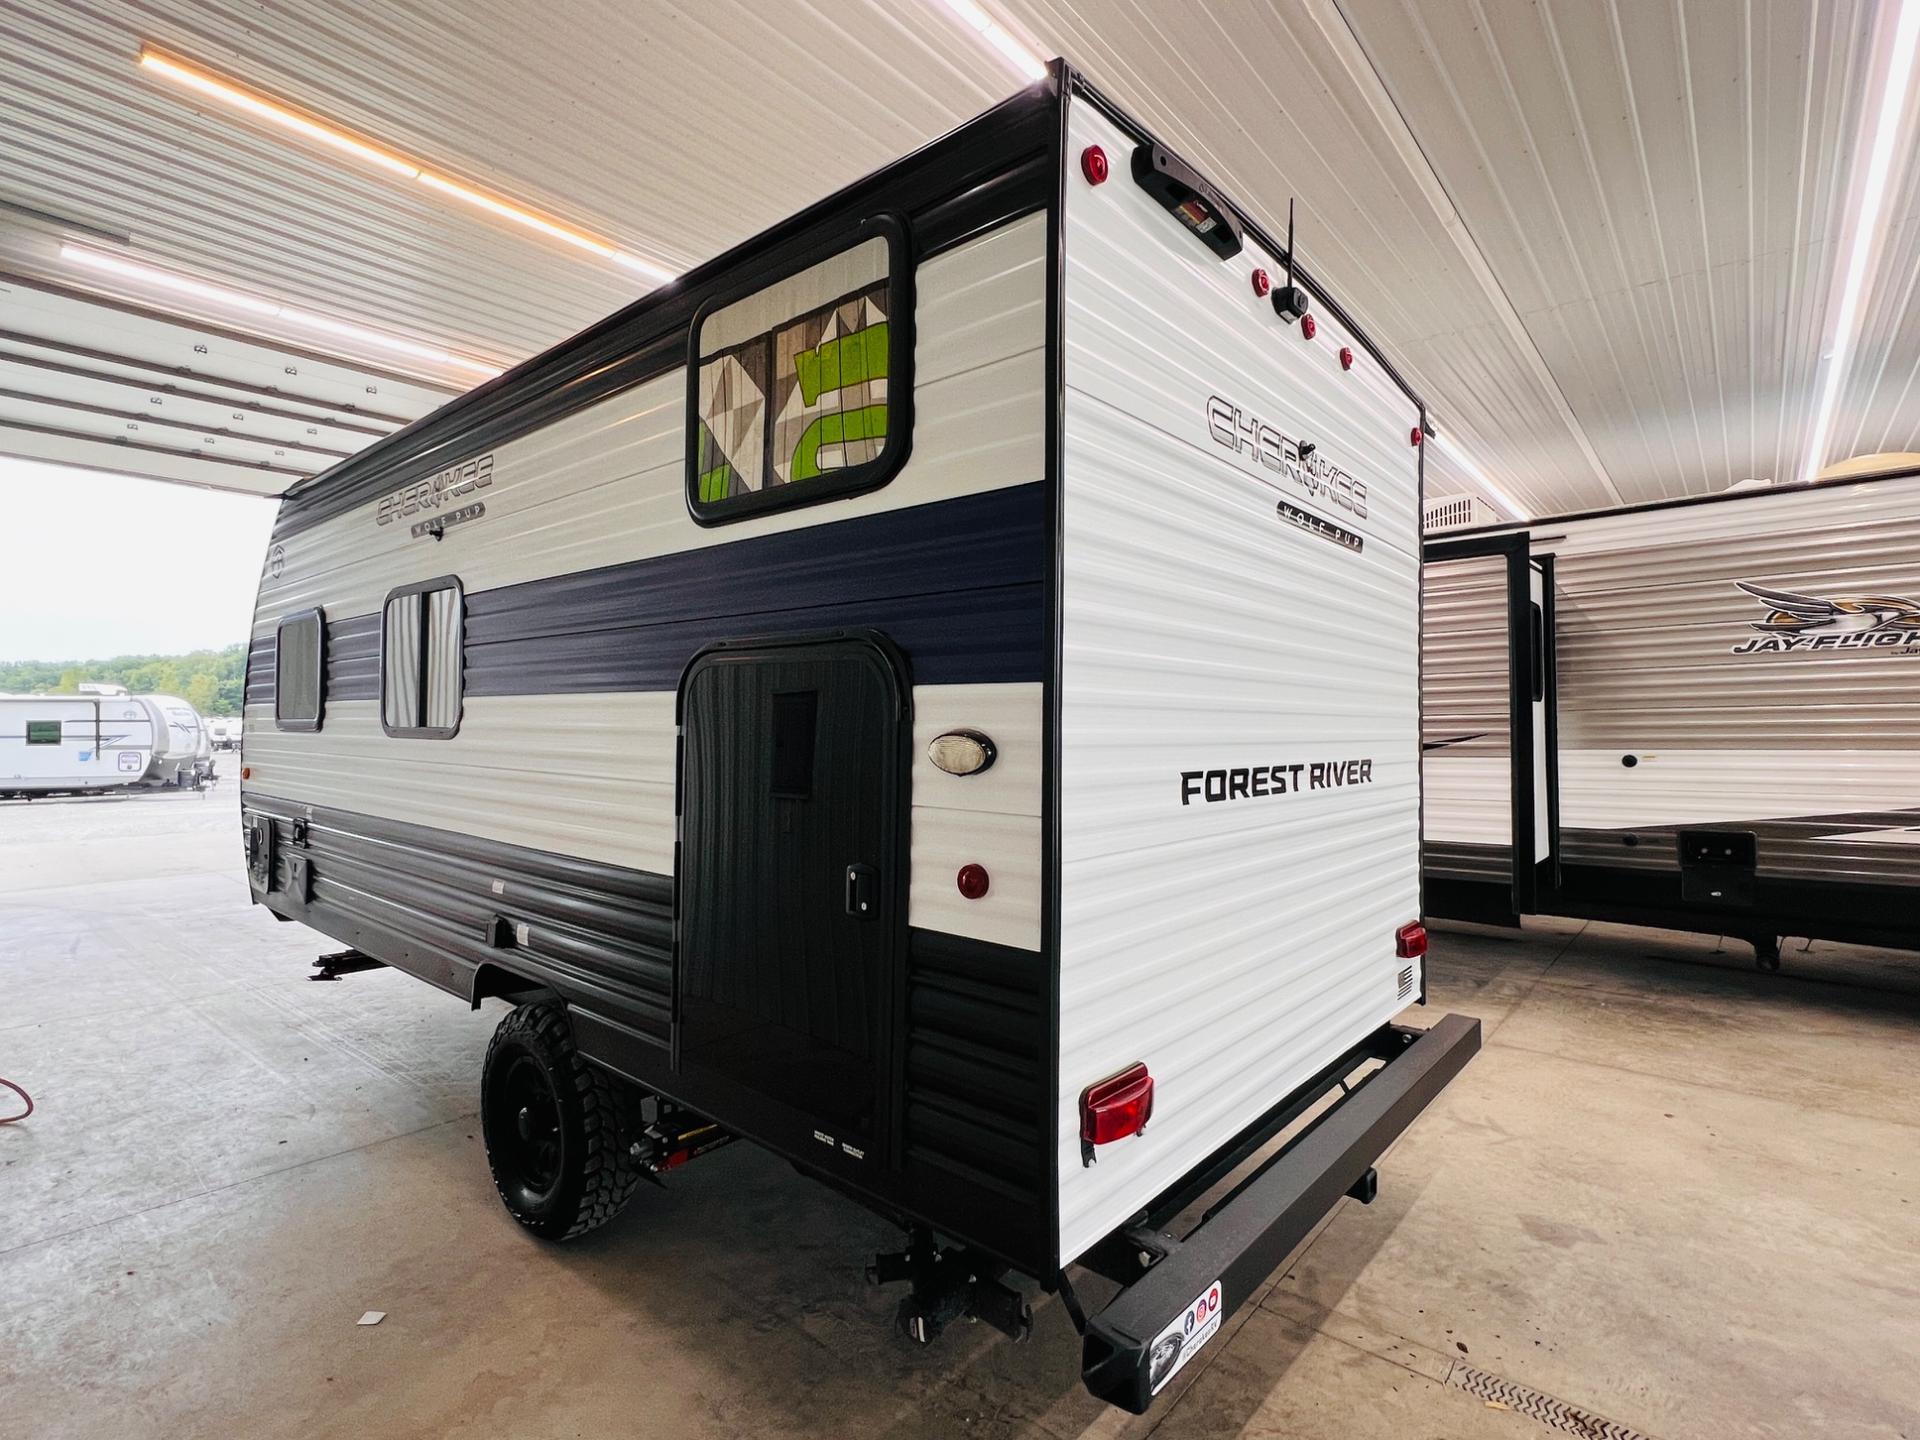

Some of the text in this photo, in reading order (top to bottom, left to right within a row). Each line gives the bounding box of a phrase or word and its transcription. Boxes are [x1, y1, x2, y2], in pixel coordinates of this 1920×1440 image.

[455, 505, 480, 521] PUP
[1283, 504, 1360, 548] WOLF PUP
[1733, 635, 1806, 654] JAY
[1180, 758, 1373, 806] FOREST RIVER
